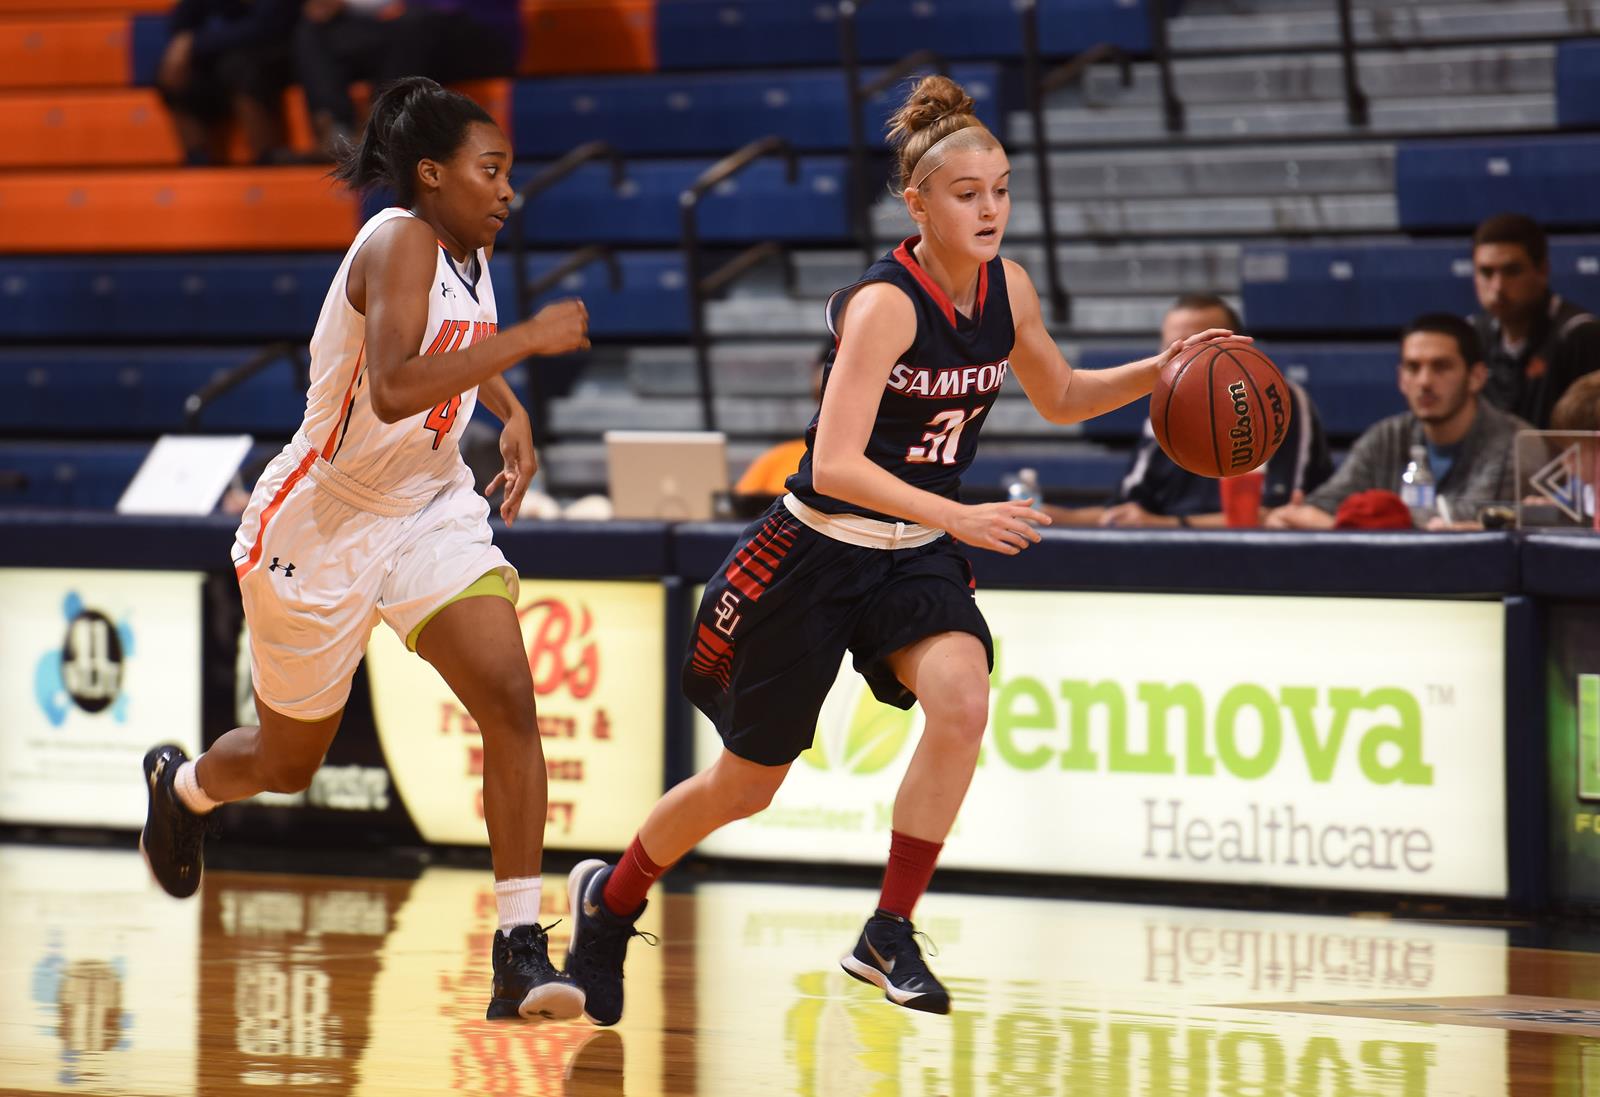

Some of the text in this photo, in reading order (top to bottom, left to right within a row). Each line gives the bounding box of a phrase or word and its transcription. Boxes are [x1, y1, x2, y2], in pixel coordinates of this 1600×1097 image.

[423, 394, 461, 450] 4
[905, 405, 985, 465] 31
[1228, 380, 1254, 468] Wilson
[1265, 383, 1285, 446] NCAA
[977, 636, 1434, 786] ennova
[1142, 797, 1434, 874] Healthcare
